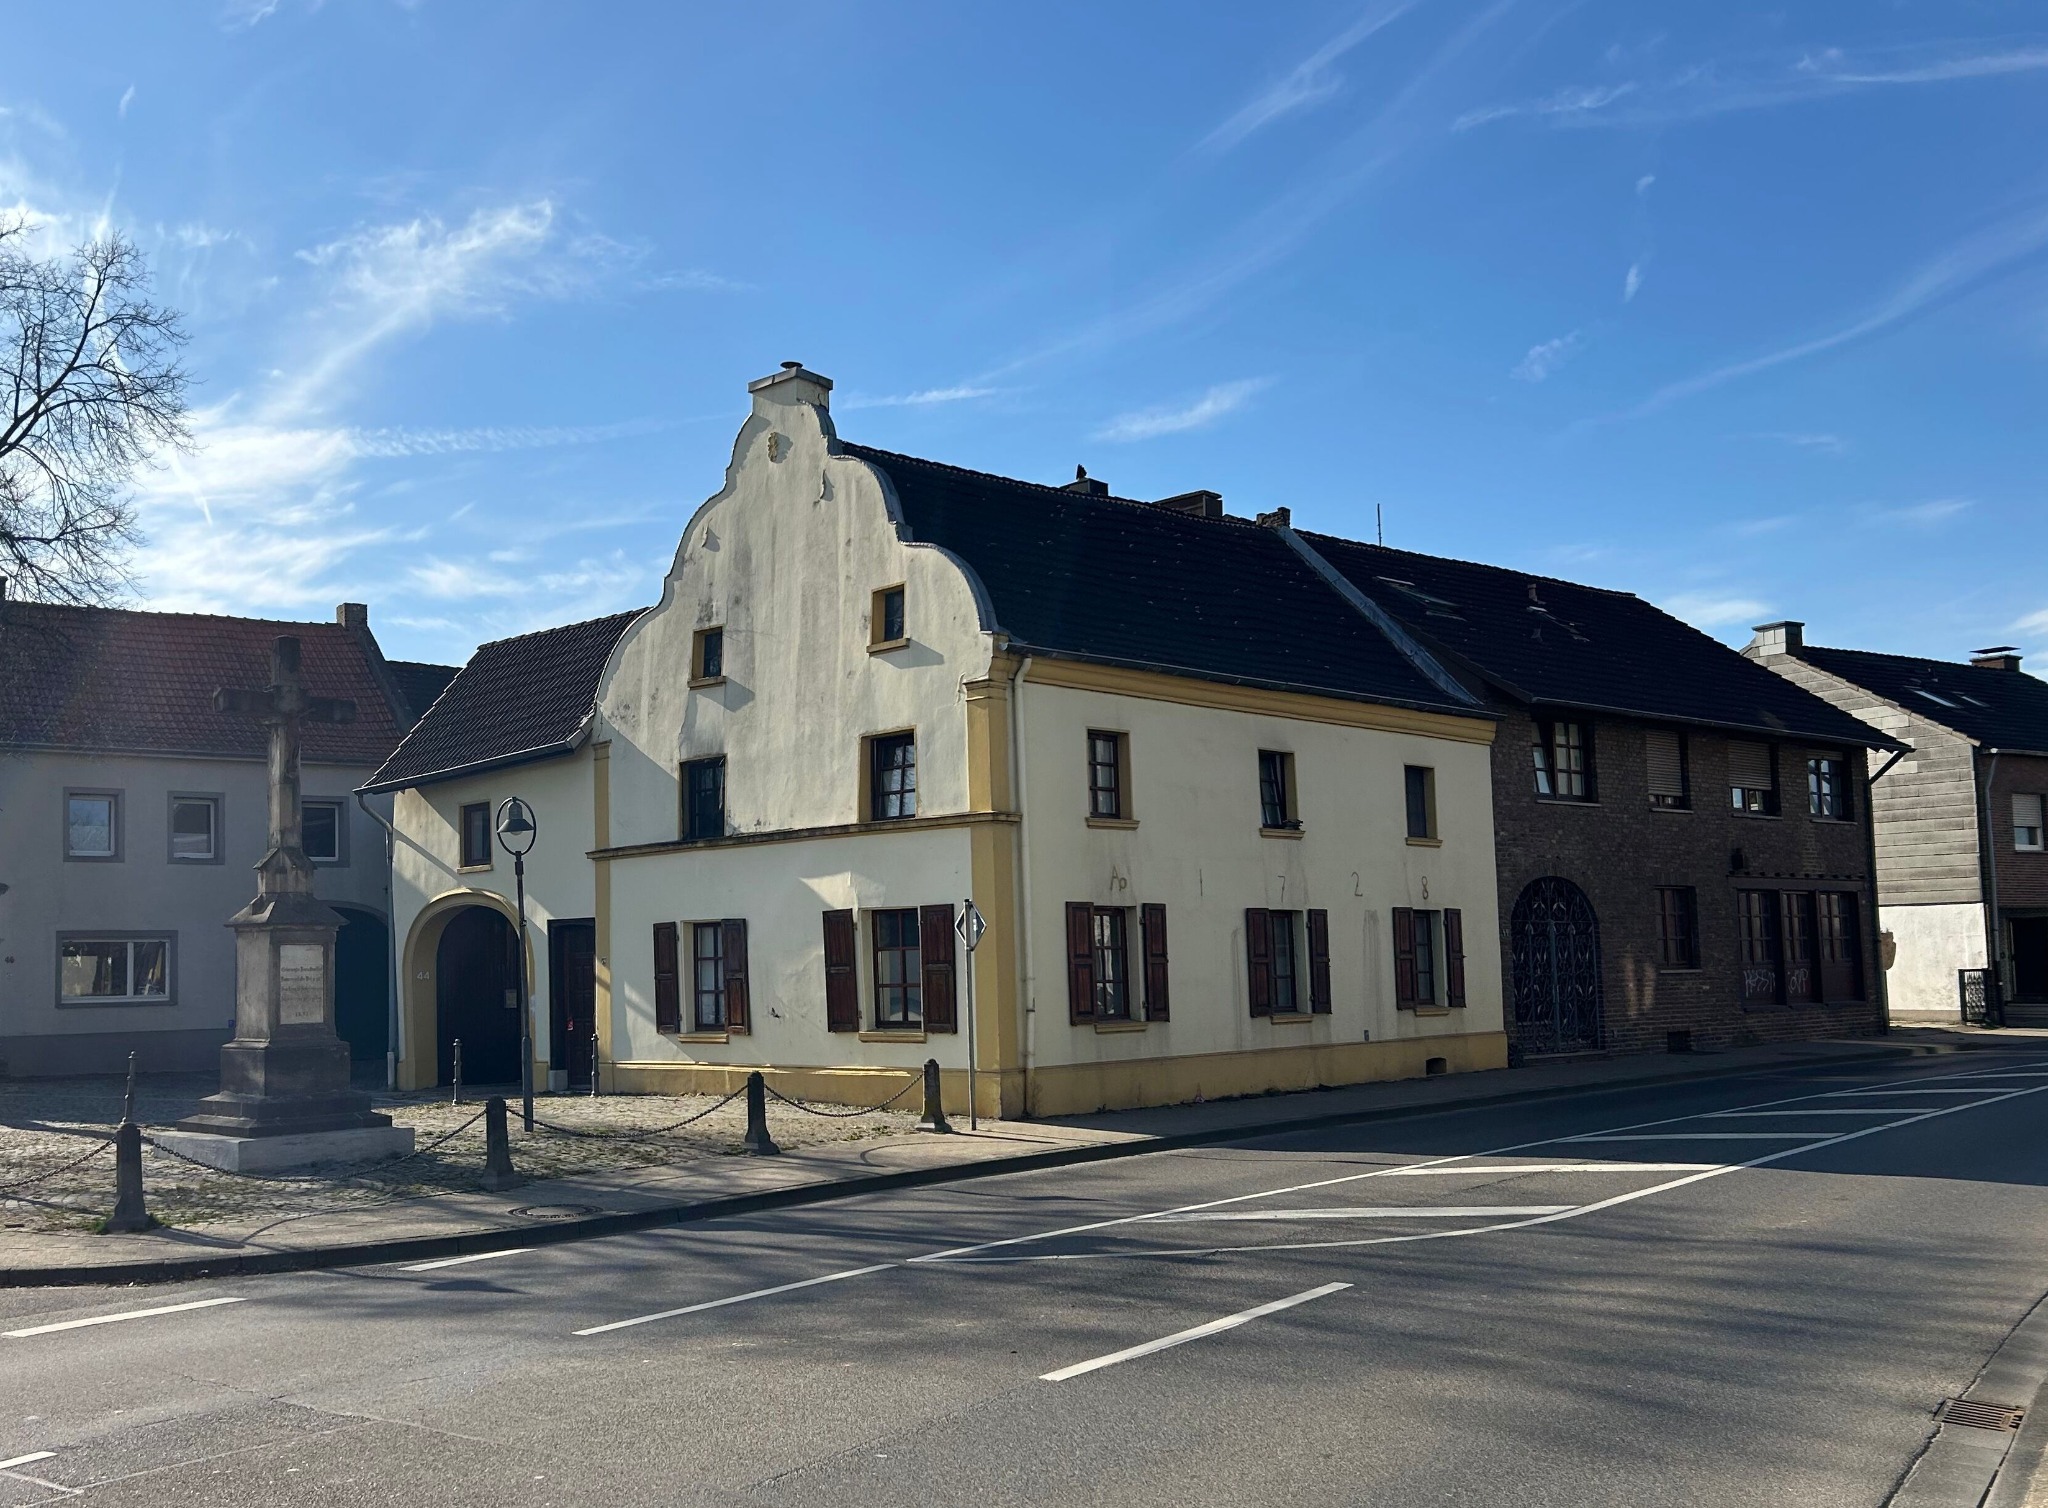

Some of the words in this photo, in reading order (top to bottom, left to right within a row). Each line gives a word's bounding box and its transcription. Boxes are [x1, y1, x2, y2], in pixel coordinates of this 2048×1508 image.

[1277, 875, 1286, 903] 7
[1351, 871, 1363, 897] 2
[1421, 875, 1429, 900] 8
[416, 971, 430, 981] 44
